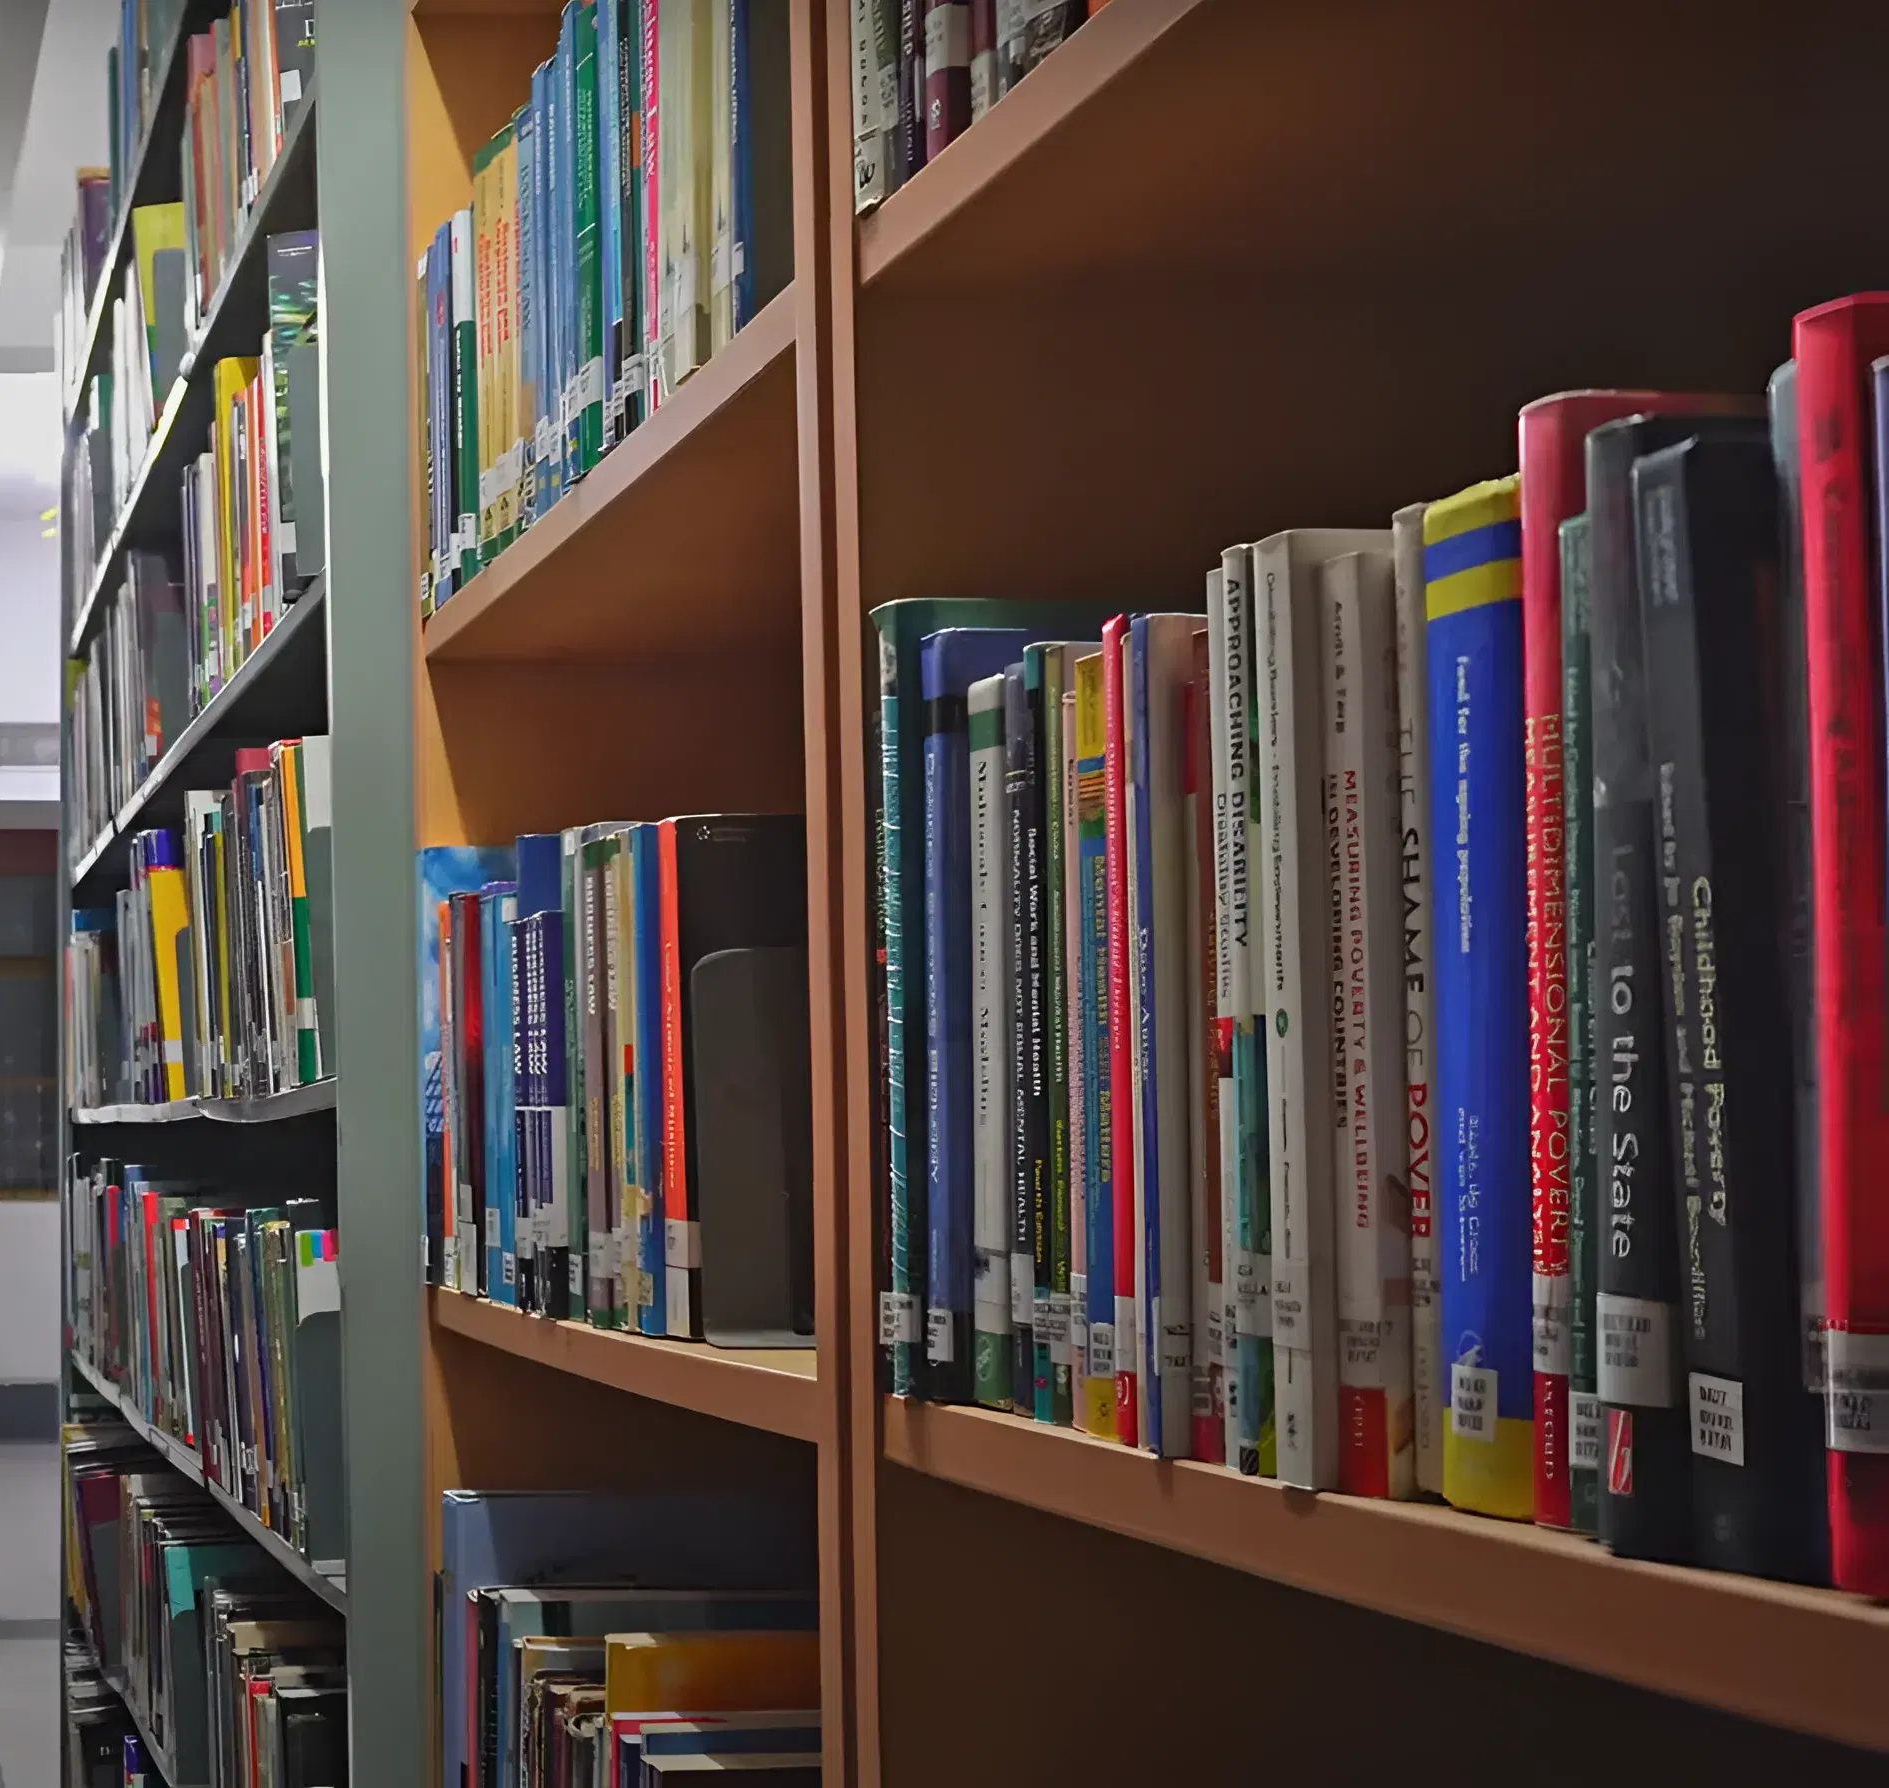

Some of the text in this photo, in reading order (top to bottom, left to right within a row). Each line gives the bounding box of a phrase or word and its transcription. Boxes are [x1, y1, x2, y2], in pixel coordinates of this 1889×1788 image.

[1226, 578, 1249, 948] APPROACHING DISABILITY
[1458, 742, 1473, 775] the
[1012, 809, 1023, 918] NORMALITY
[1328, 805, 1345, 971] DEVELOPING
[1342, 769, 1364, 921] MEASURING
[1400, 827, 1425, 994] SHAME
[1541, 713, 1568, 1092] MULTIDIMENSIONAL
[511, 935, 523, 1075] BUSINESS LAW
[587, 973, 597, 1015] LAW
[1014, 977, 1024, 1016] NOT
[1028, 828, 1043, 1097] Social Work and Mental Health
[1351, 929, 1367, 1049] POVERTY
[1333, 979, 1348, 1129] COUNTRIES
[1407, 1010, 1426, 1068] OF
[1529, 1006, 1542, 1093] AND
[1610, 844, 1640, 1258] Lost to the State
[1692, 877, 1728, 1227] Childhood Poverty
[1016, 1087, 1027, 1165] MENTAL
[1355, 1081, 1370, 1229] WELLBEING
[1409, 1082, 1433, 1239] POVER
[1017, 1171, 1028, 1242] HEALTH
